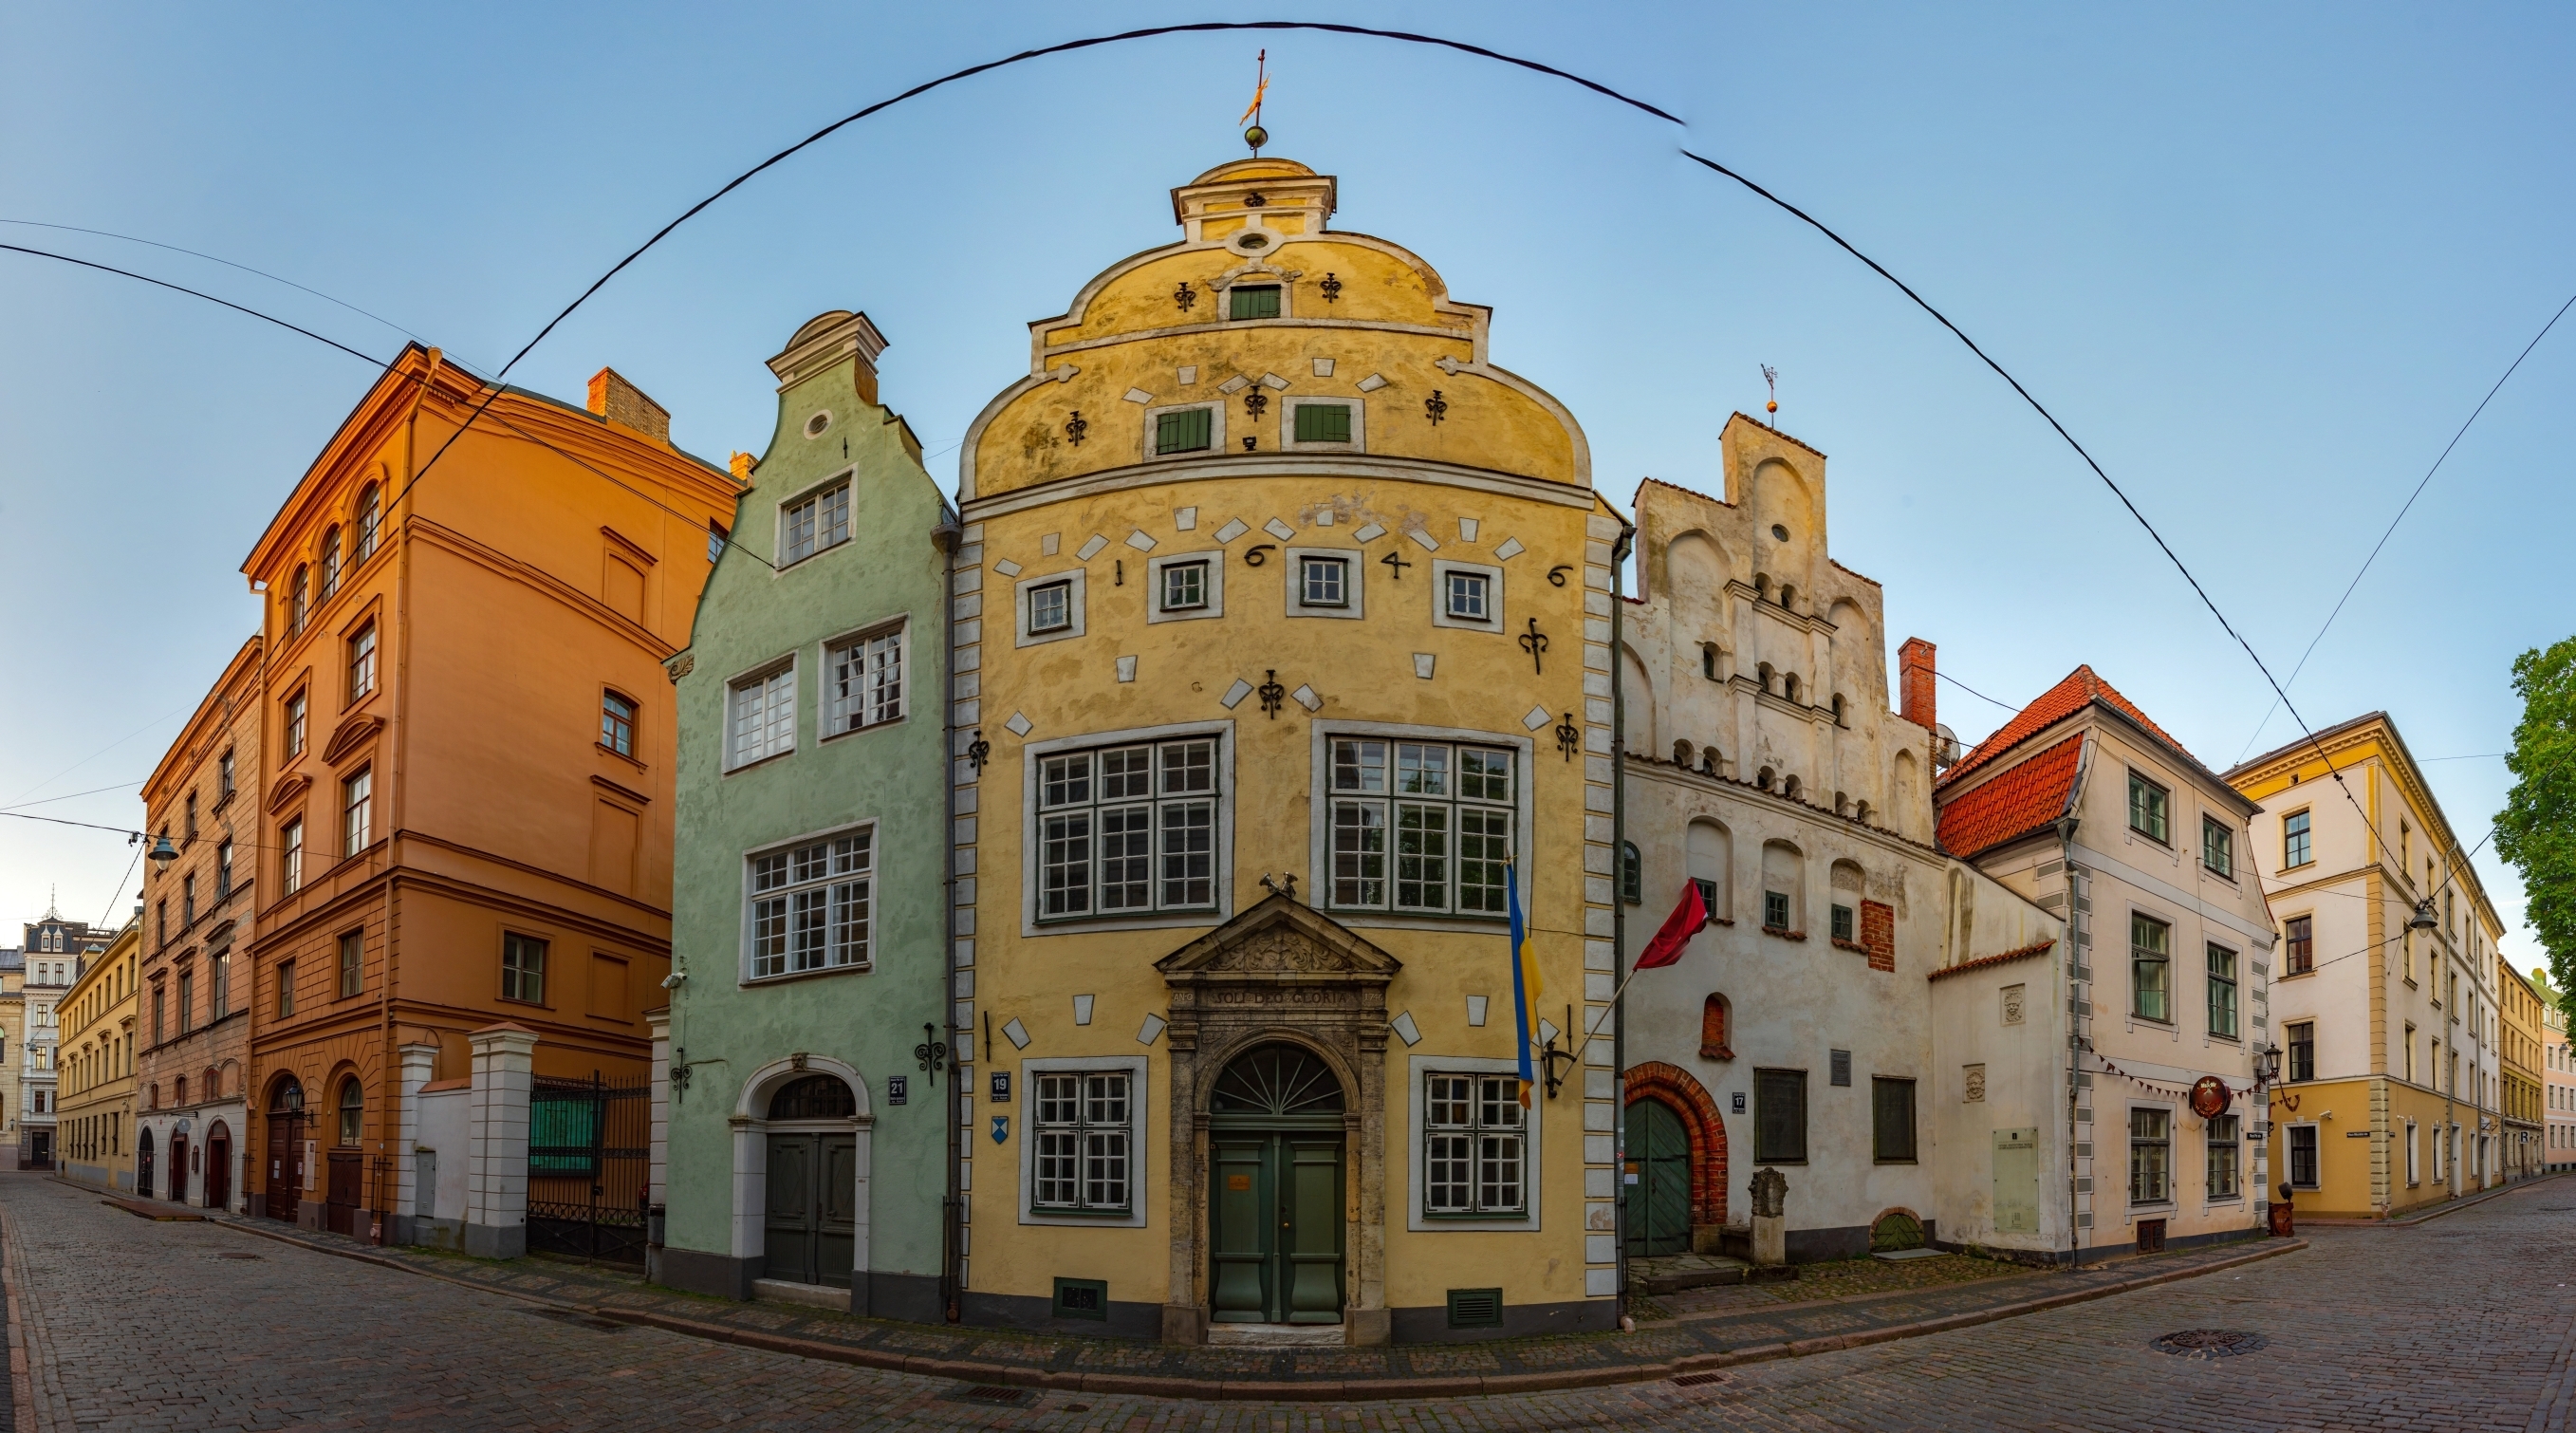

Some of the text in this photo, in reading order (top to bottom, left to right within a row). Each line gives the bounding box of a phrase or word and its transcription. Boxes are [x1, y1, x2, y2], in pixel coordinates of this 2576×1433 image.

[1214, 993, 1246, 1004] SOLI
[1254, 993, 1283, 1004] DEO
[1292, 993, 1347, 1004] GLORIA
[890, 1082, 903, 1094] 21
[993, 1078, 1008, 1090] 19
[1734, 1096, 1744, 1106] 17
[2520, 1131, 2529, 1143] R
